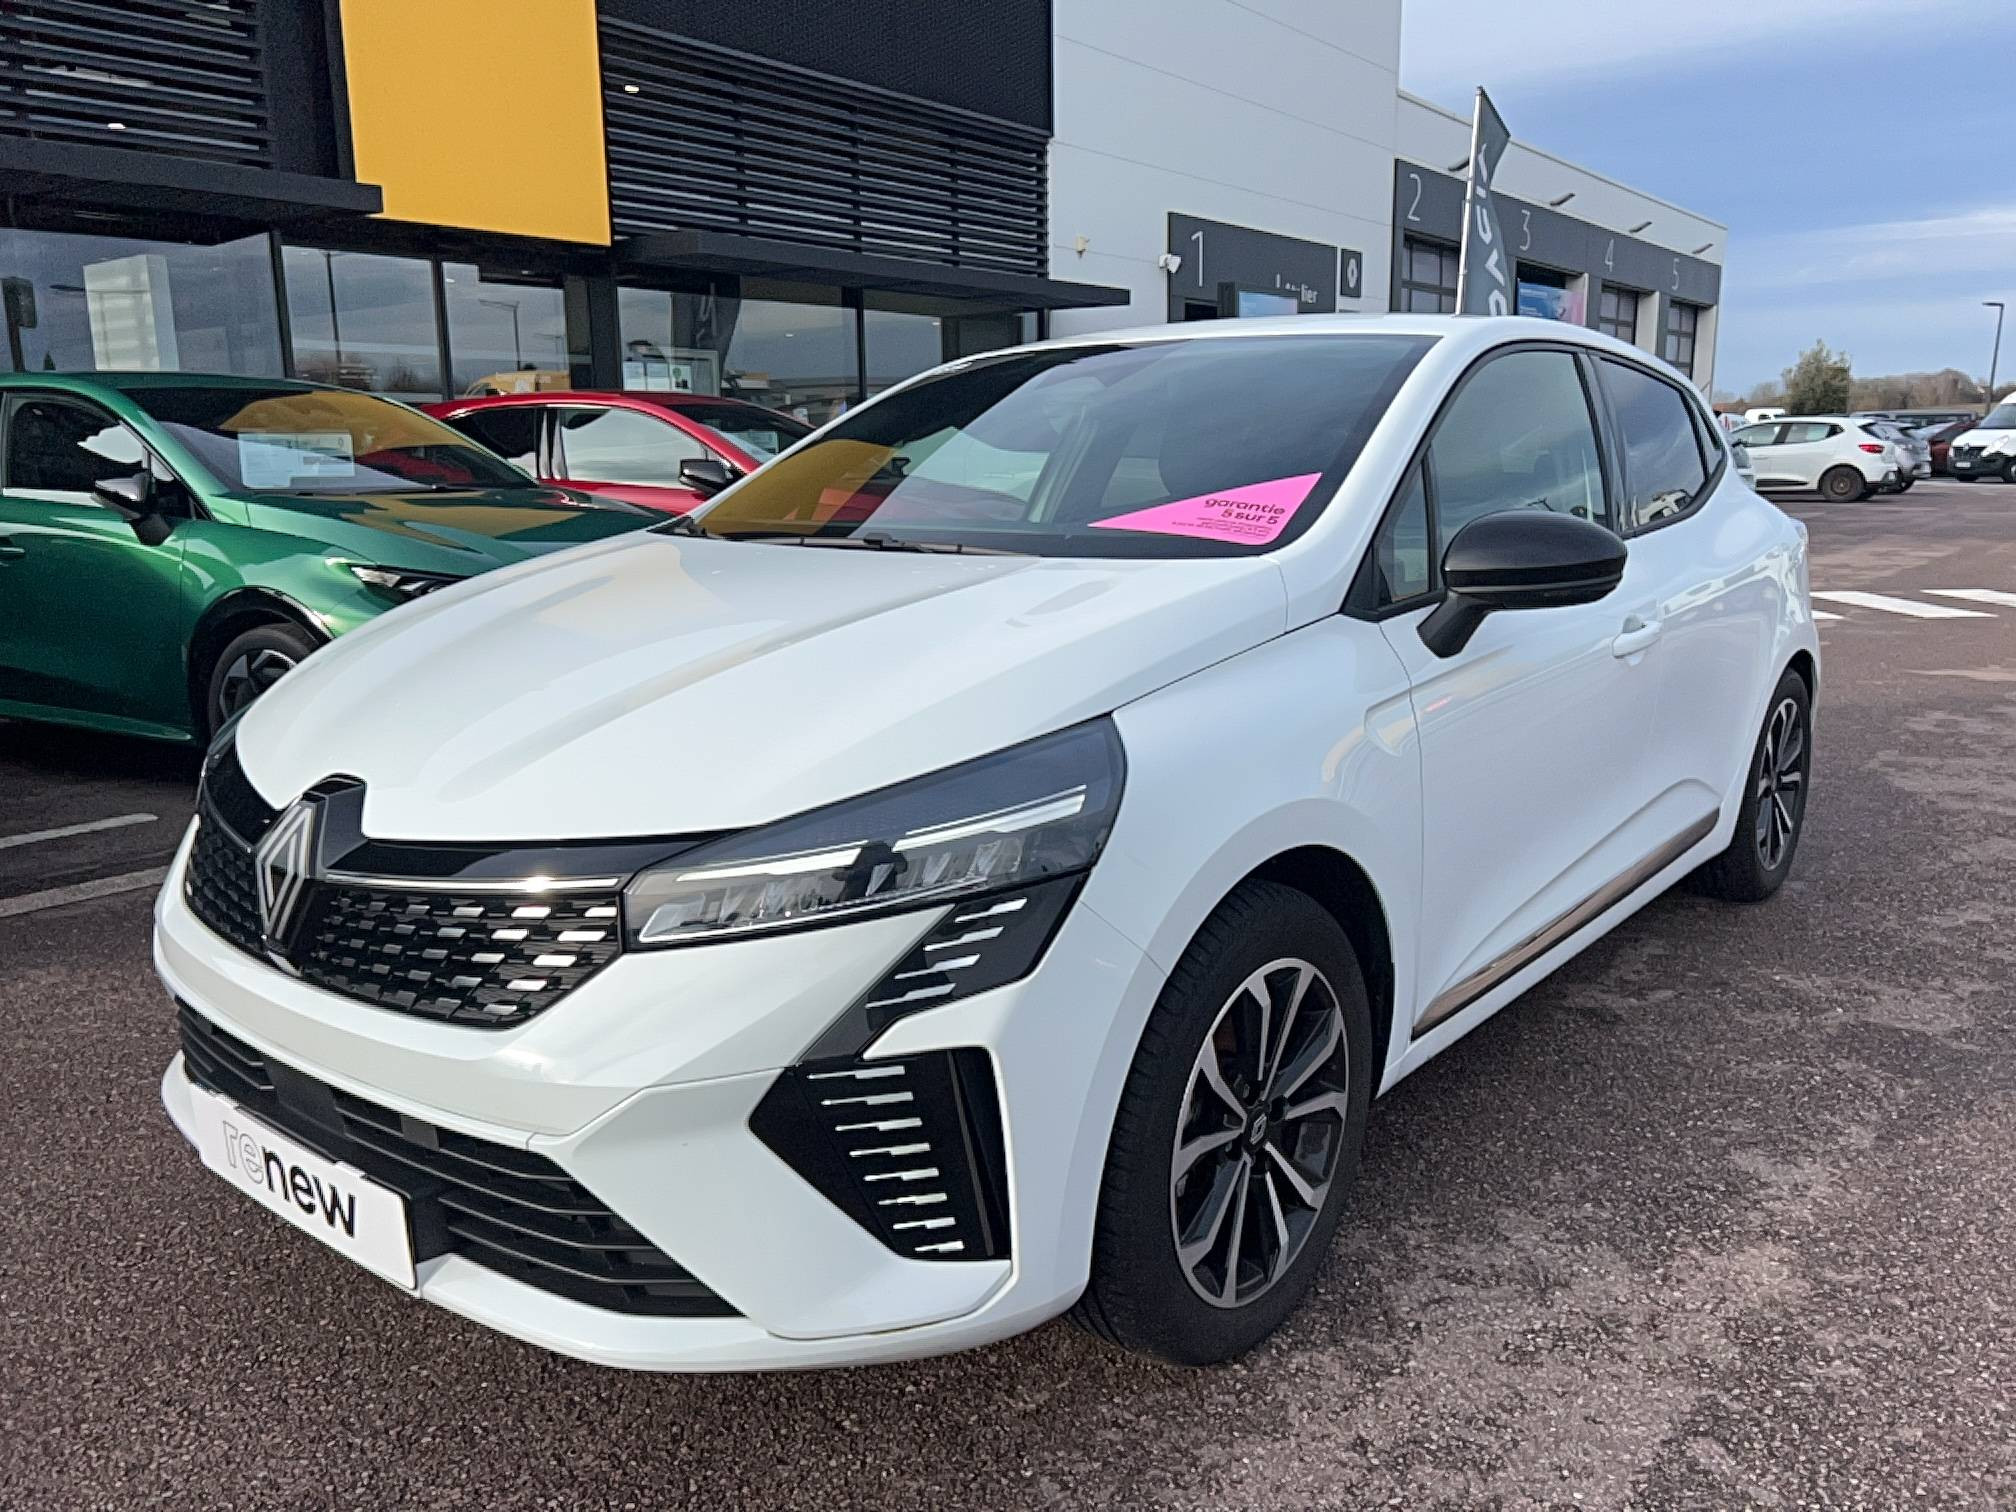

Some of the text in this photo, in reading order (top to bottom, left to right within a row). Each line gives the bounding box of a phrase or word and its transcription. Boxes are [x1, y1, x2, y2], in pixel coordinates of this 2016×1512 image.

[1407, 173, 1422, 222] 2
[1519, 208, 1532, 251] 3
[1190, 230, 1204, 288] 1
[1604, 238, 1615, 273] 4
[1671, 257, 1680, 291] 5
[1204, 498, 1285, 515] garantie
[1220, 508, 1280, 525] 5 sur 5
[222, 1119, 356, 1239] renew
